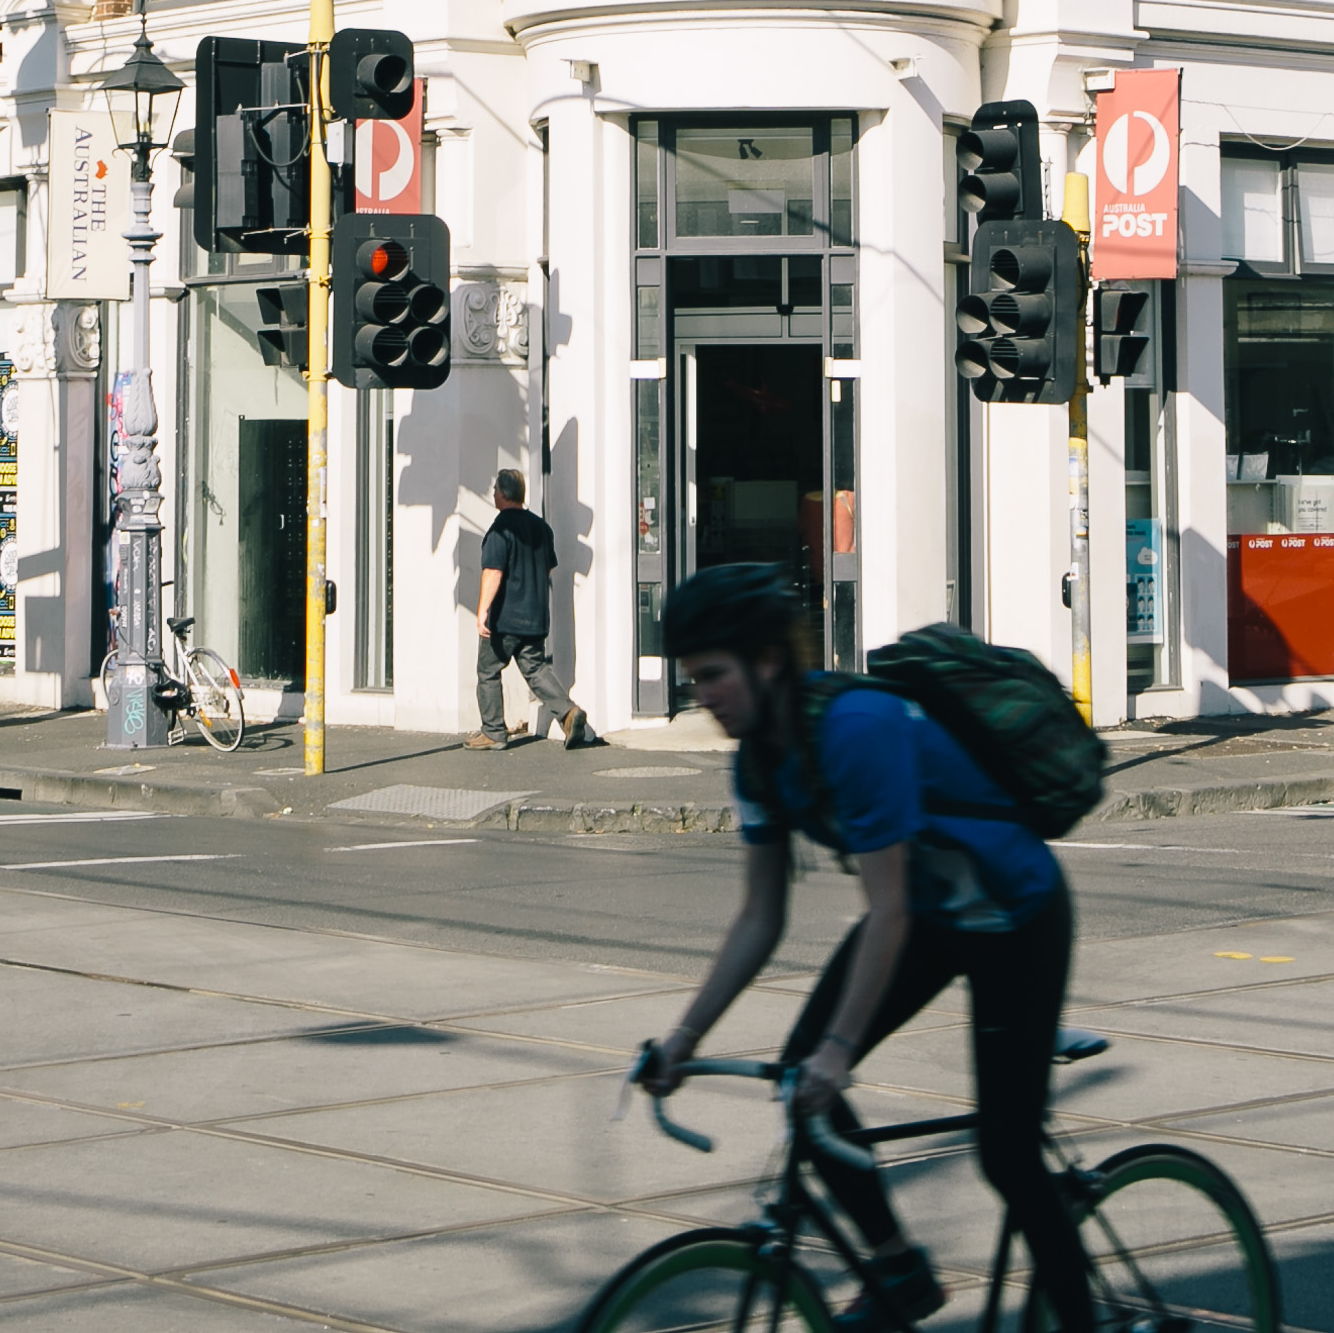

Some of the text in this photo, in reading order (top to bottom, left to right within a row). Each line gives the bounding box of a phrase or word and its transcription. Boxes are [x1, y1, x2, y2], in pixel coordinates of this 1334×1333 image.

[71, 126, 93, 282] AUSTRALIAN
[91, 184, 107, 232] THE
[1103, 203, 1146, 214] AUSTRALIA
[1102, 212, 1168, 238] POST
